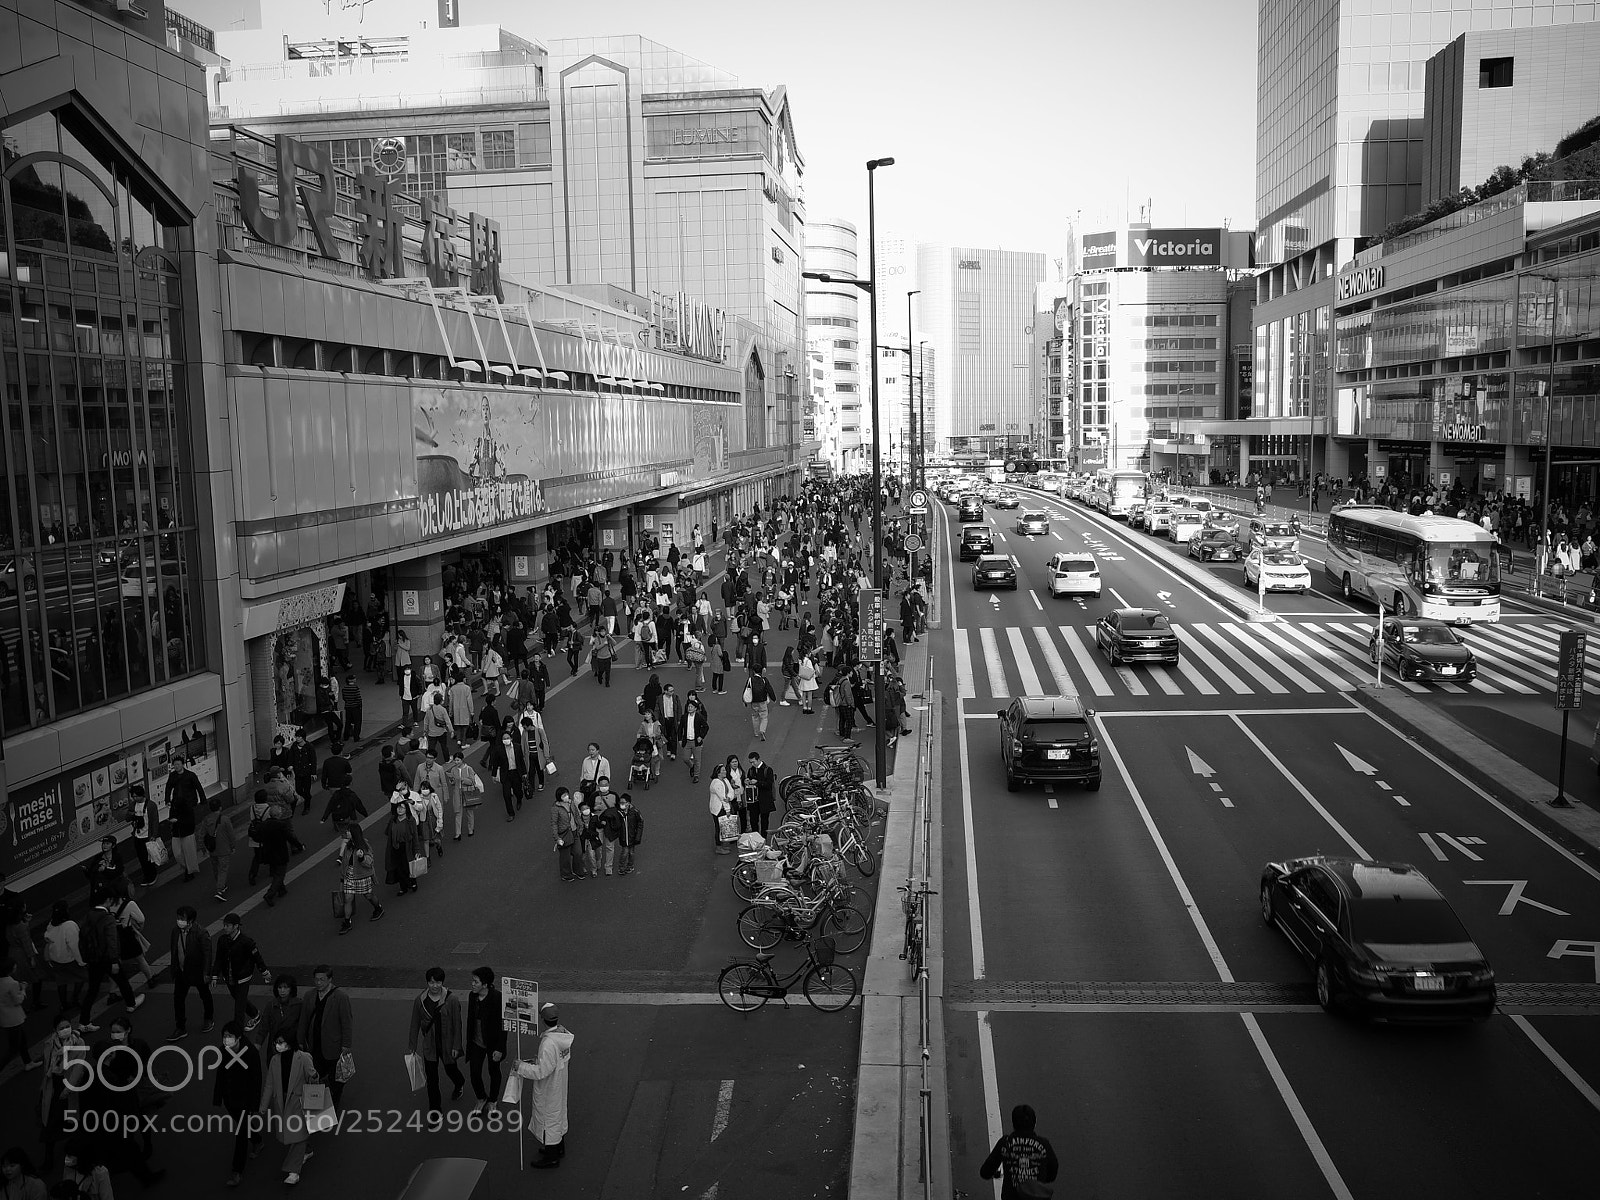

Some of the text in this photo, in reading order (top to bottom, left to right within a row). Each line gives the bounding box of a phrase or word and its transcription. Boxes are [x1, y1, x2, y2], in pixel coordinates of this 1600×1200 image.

[1134, 238, 1213, 257] Victoria
[19, 788, 56, 818] meshi
[20, 807, 54, 832] mase
